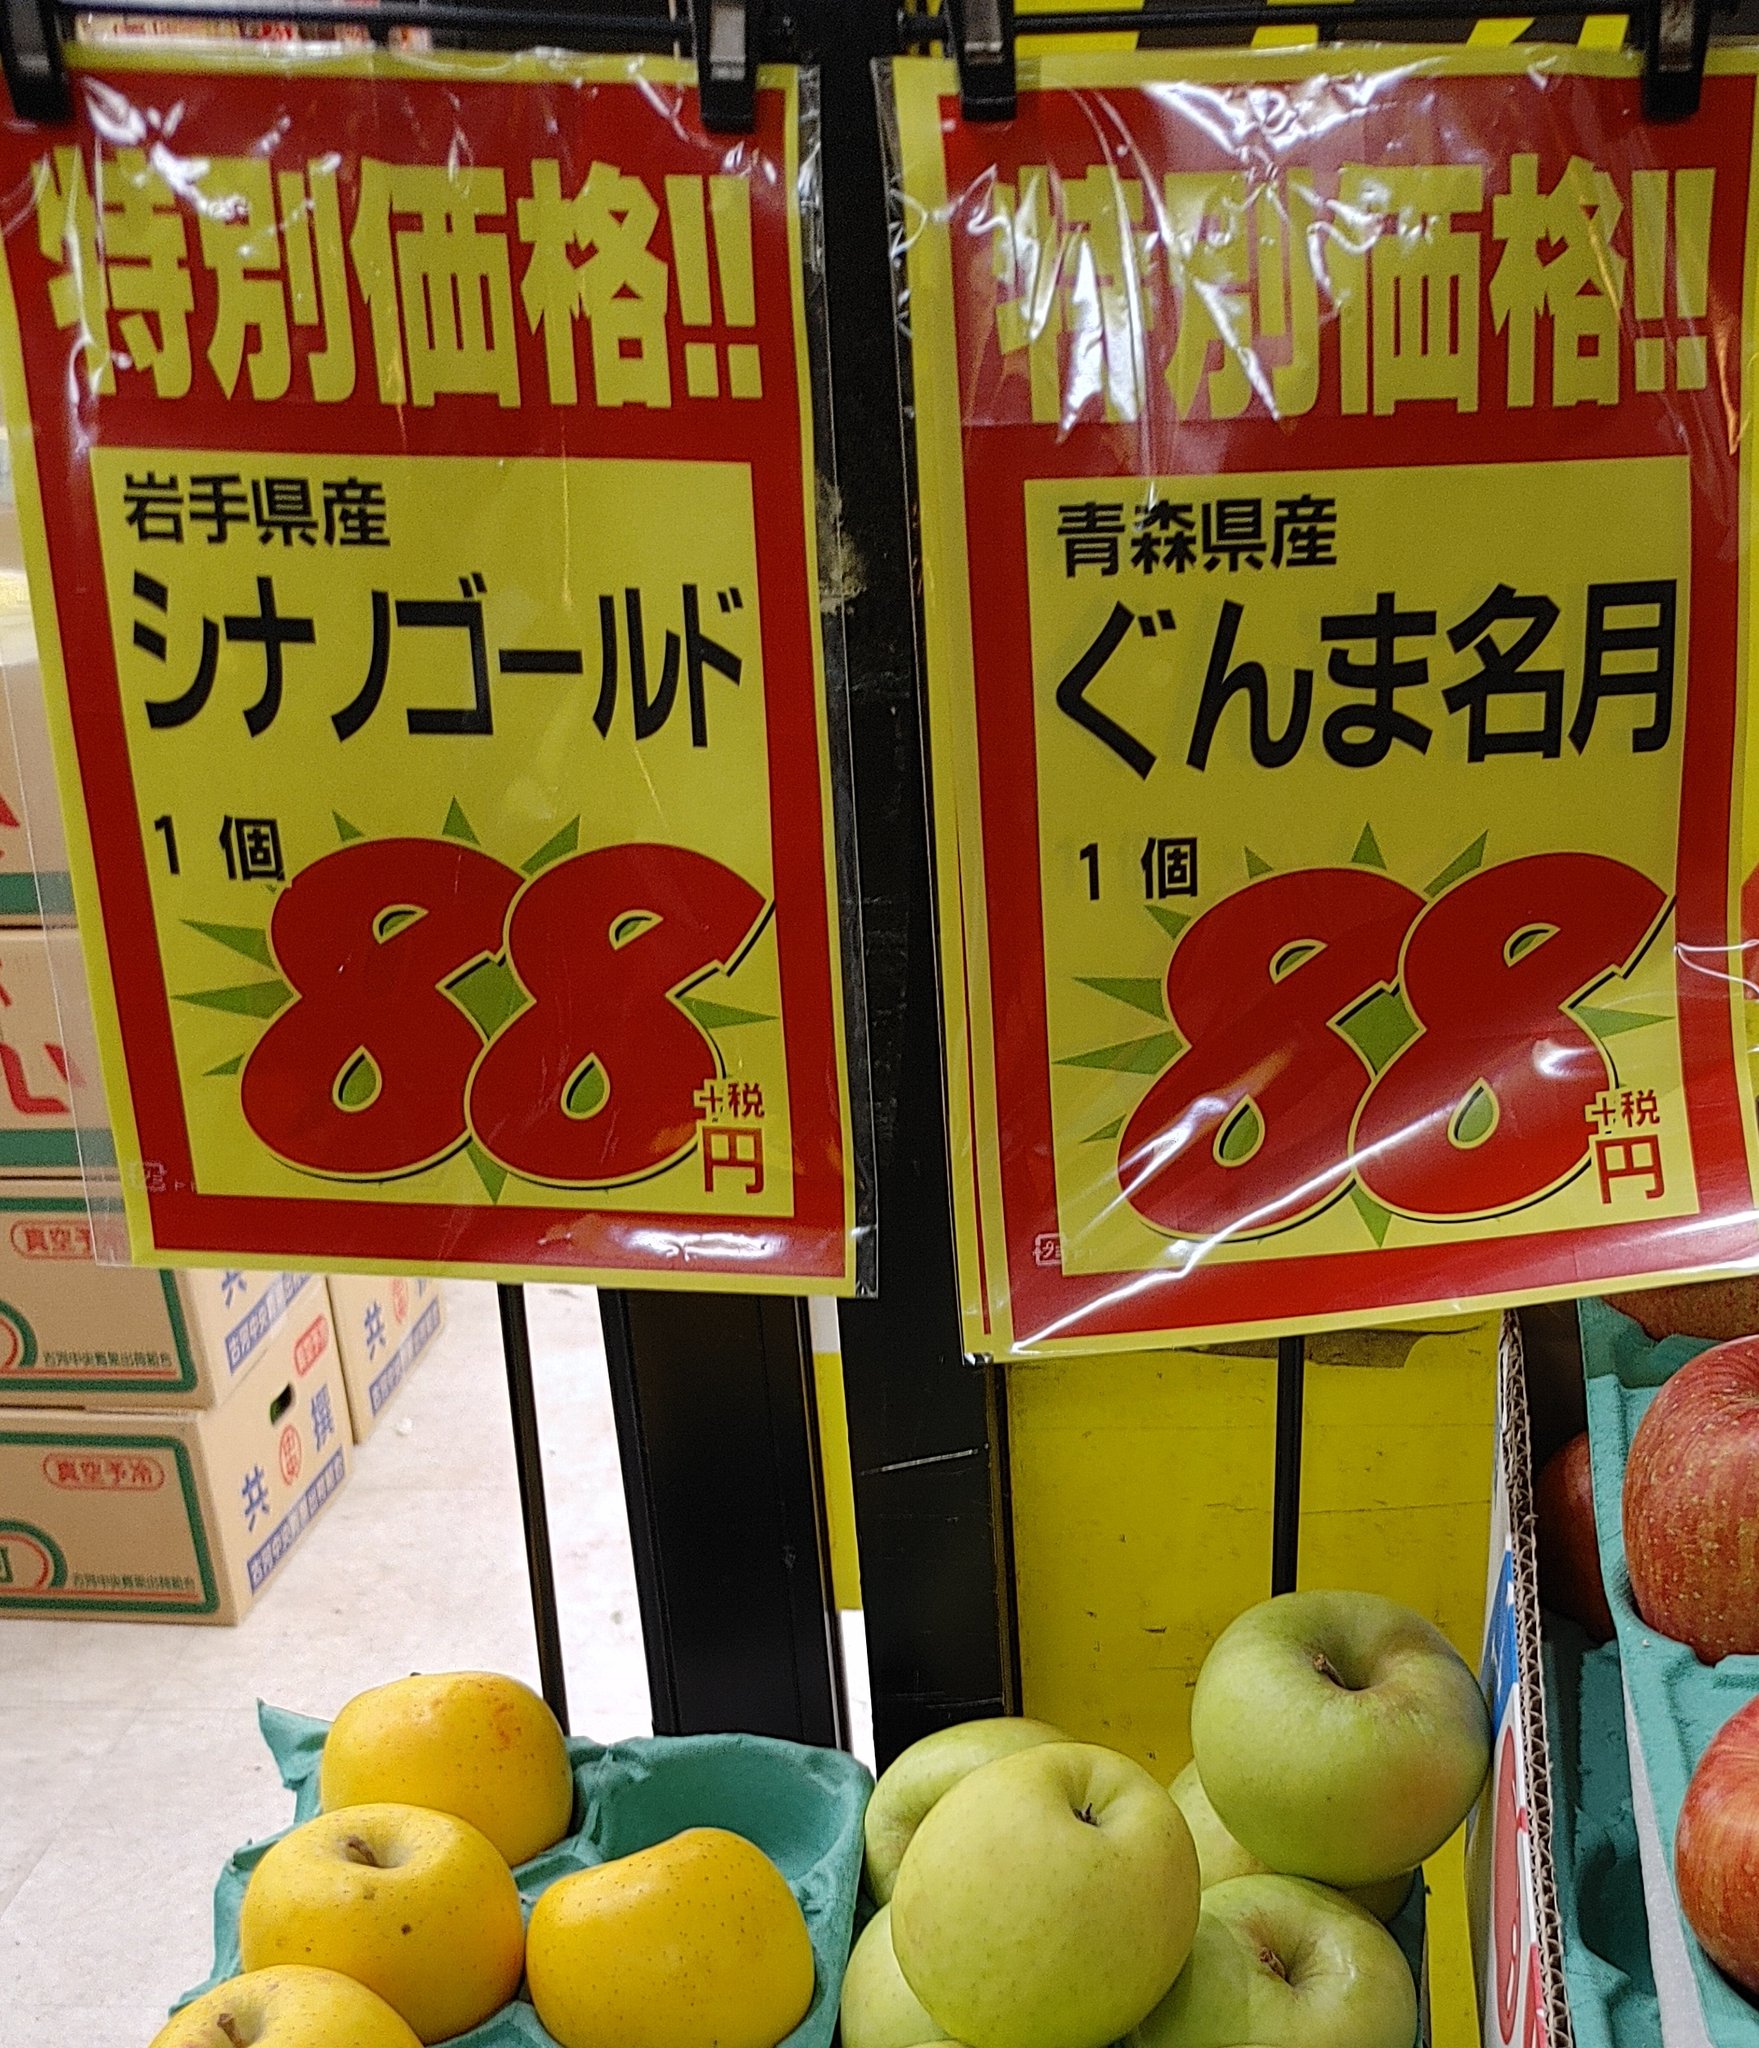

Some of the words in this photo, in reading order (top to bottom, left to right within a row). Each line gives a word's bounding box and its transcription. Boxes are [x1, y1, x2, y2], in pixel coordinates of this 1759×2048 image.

[30, 145, 763, 409] 特別価格!!
[124, 472, 391, 547] 岩手県産
[1057, 494, 1338, 579] 青森県産
[132, 570, 744, 748] シナノゴールド
[1054, 578, 1678, 780] ぐんま名月
[241, 838, 776, 1190] 88
[1118, 852, 1677, 1243] 88
[703, 1126, 764, 1197] 円
[1598, 1135, 1665, 1206] 円
